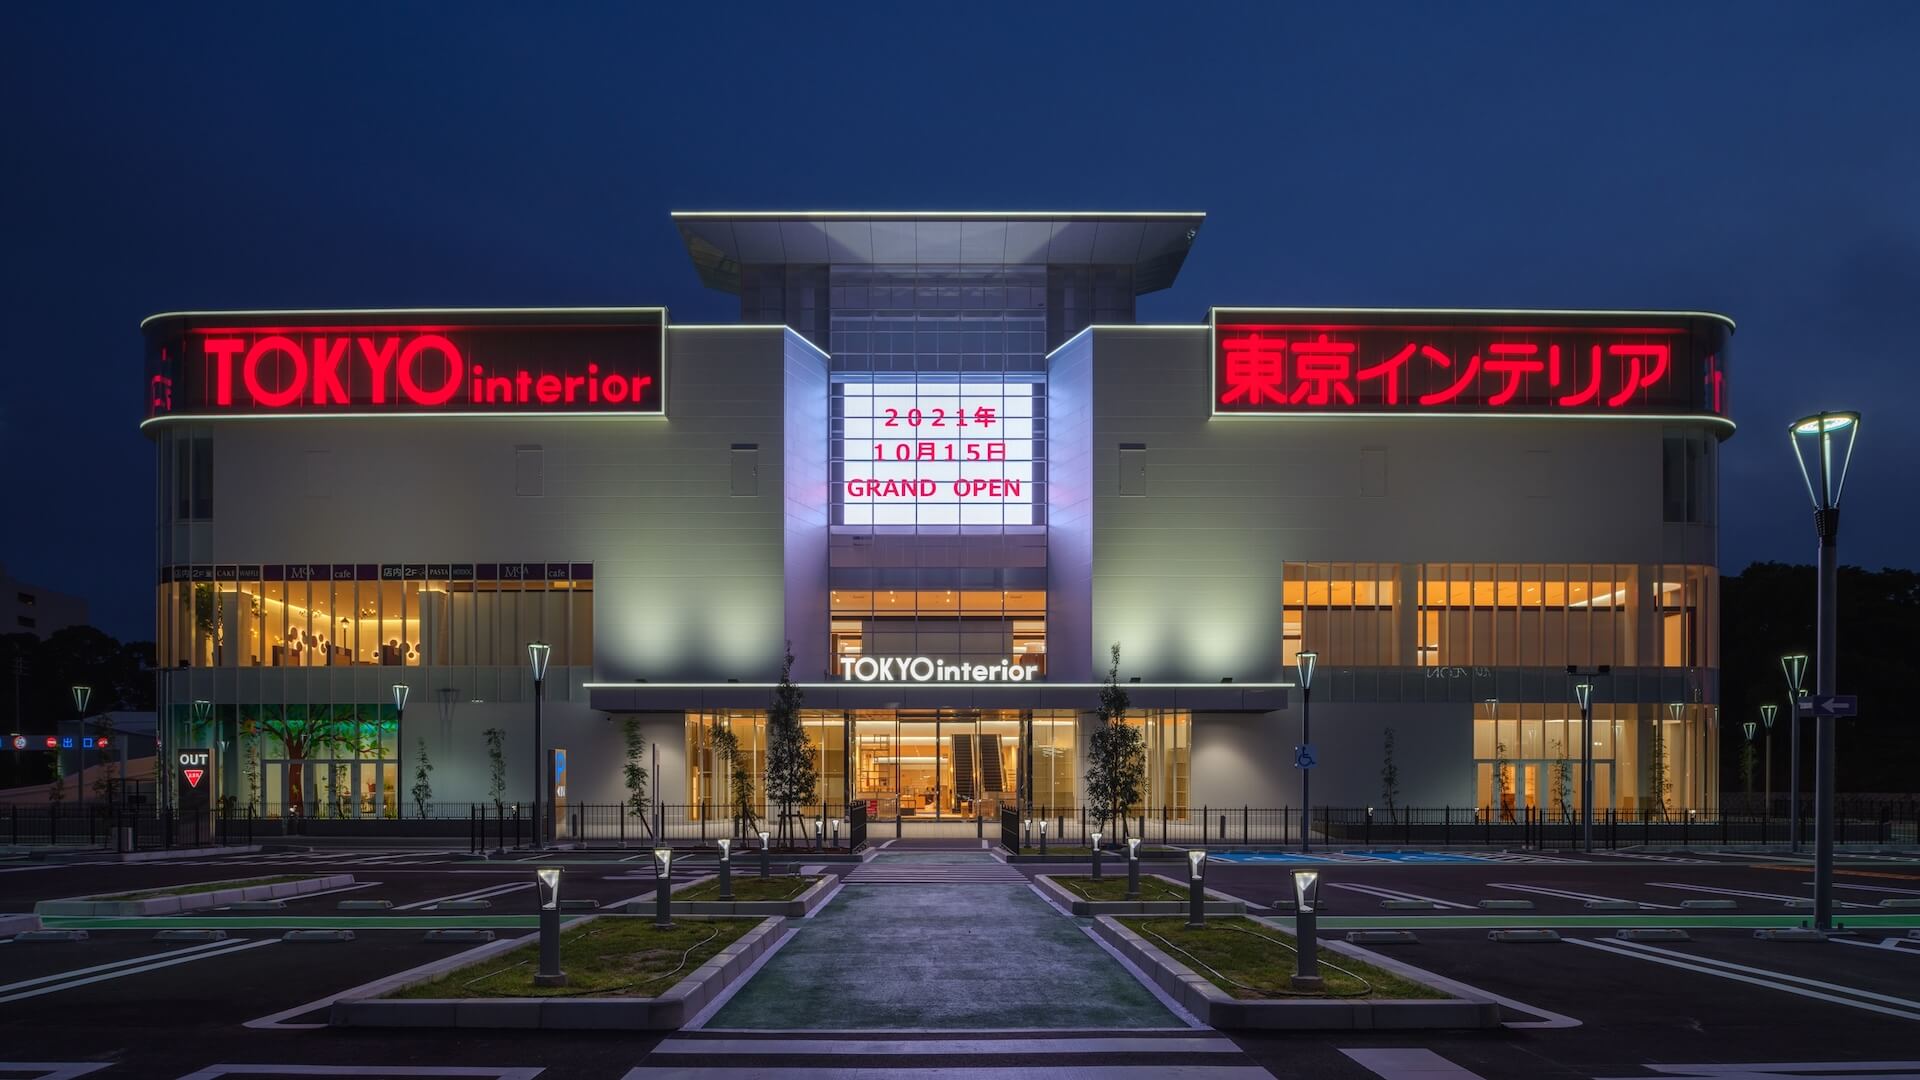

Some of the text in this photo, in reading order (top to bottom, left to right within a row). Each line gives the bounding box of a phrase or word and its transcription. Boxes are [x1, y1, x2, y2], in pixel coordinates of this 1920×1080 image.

[204, 335, 464, 407] TOKYO
[473, 363, 652, 403] interior
[1221, 333, 1668, 407] 東京インテリア
[884, 406, 996, 428] 2021年
[874, 442, 1006, 463] 10月15日
[847, 478, 1021, 497] GRAND OPEN
[840, 656, 1039, 682] TOKYO interior
[62, 737, 93, 748] 出口
[179, 753, 209, 765] OUT
